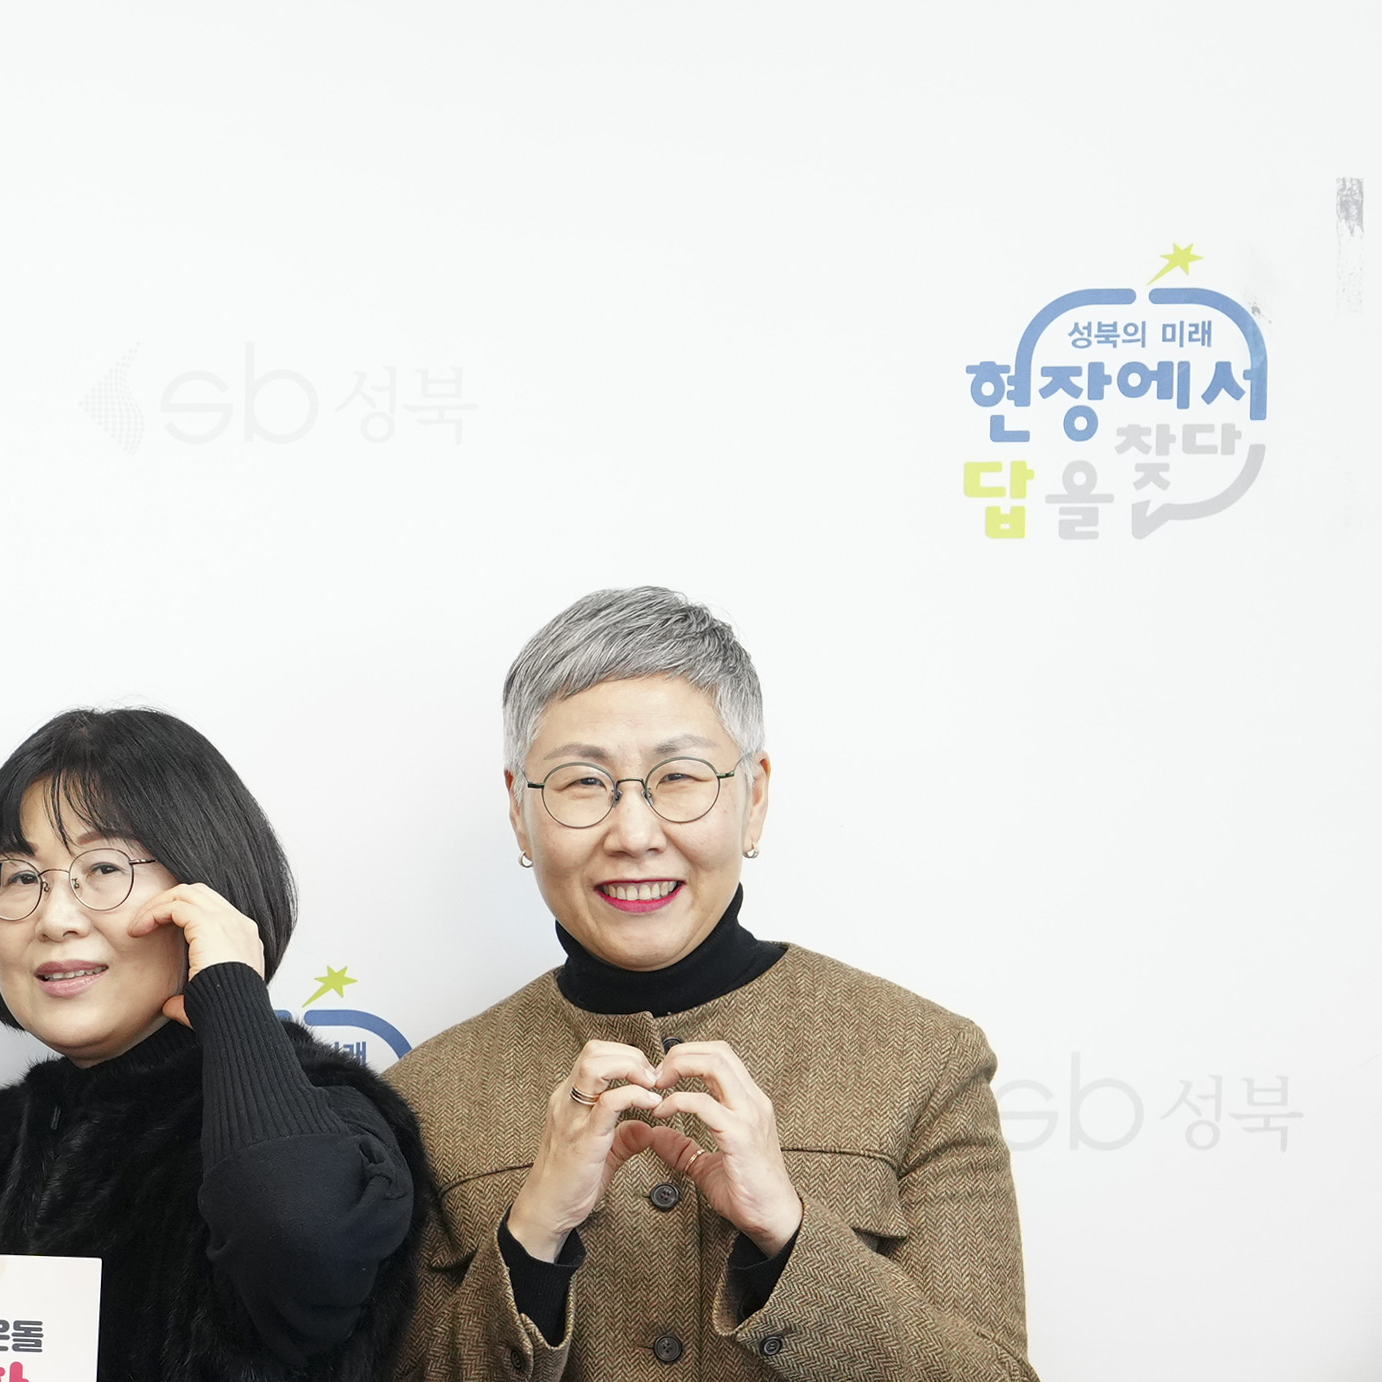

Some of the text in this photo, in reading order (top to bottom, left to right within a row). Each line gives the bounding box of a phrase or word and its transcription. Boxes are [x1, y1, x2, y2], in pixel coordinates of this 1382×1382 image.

[1068, 320, 1212, 349] 성북의 미래
[334, 365, 478, 446] 성북
[965, 361, 1267, 442] 현장에서
[1159, 1074, 1304, 1153] 성북
